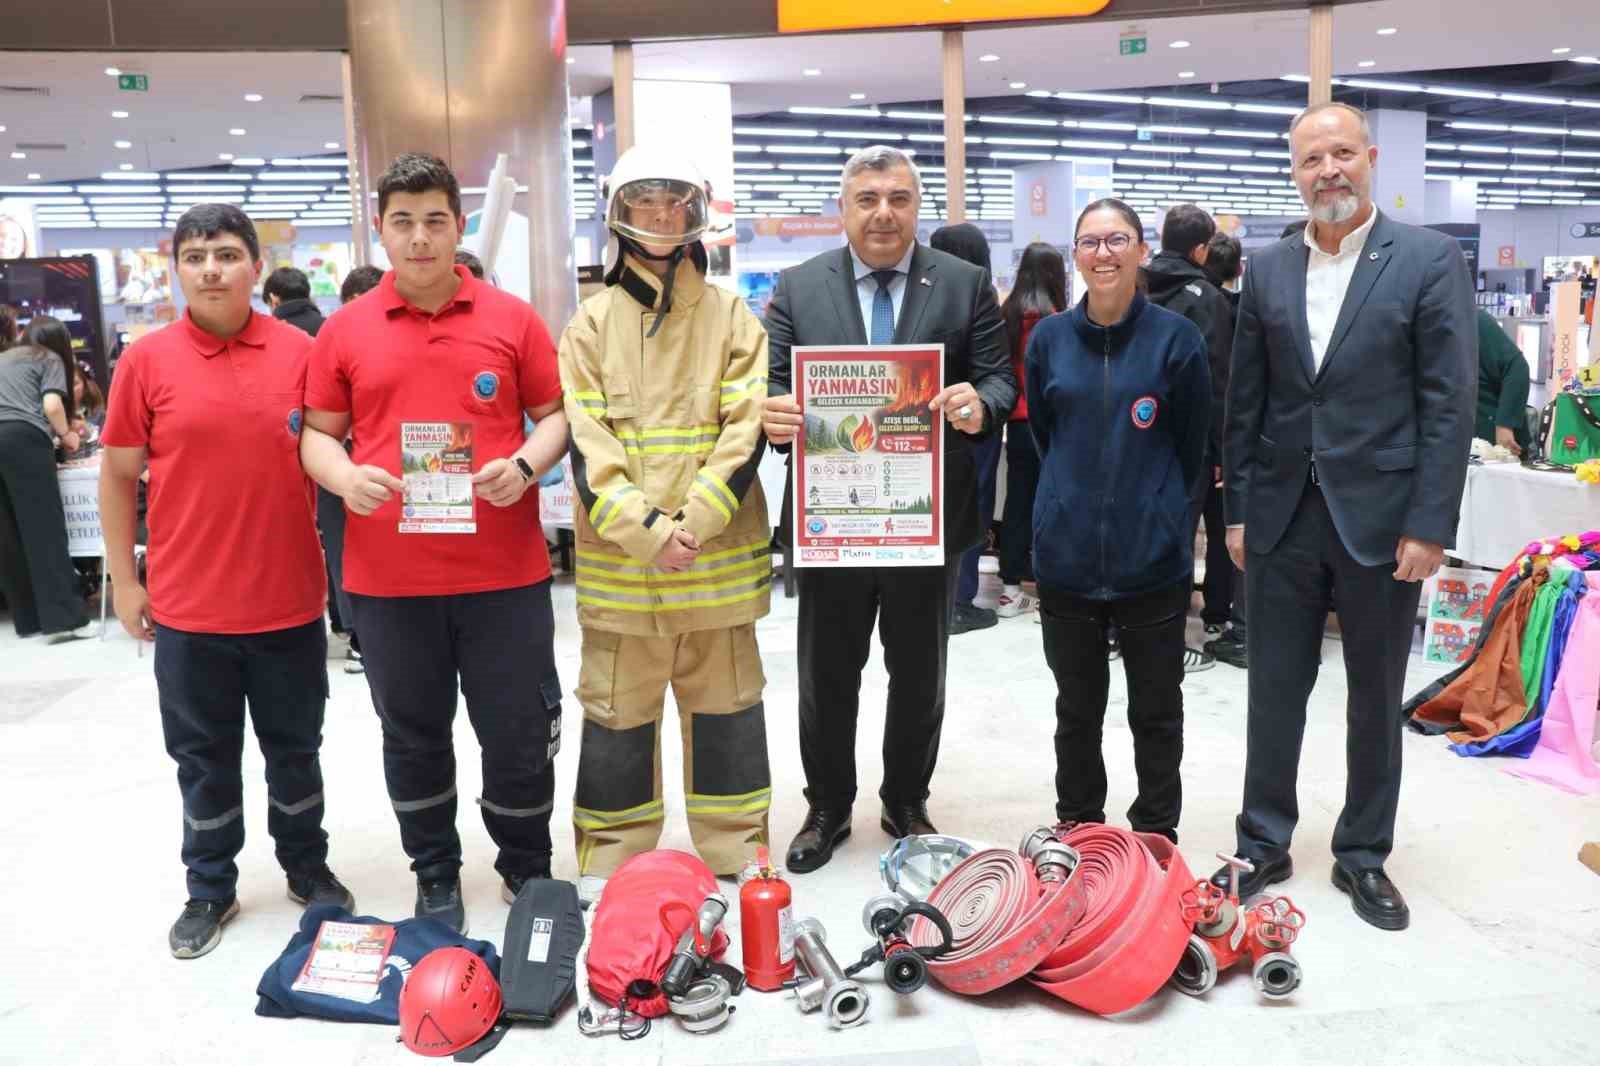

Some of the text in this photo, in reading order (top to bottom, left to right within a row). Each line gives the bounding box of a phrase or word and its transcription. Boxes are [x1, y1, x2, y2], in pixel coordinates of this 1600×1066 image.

[809, 364, 886, 378] ORMANLAR
[1584, 369, 1592, 382] 1
[808, 378, 897, 395] YANMASIN
[404, 425, 447, 433] ORMANLAR
[404, 433, 452, 441] YANMASIN
[895, 440, 911, 452] 112
[460, 958, 478, 992] CAMP
